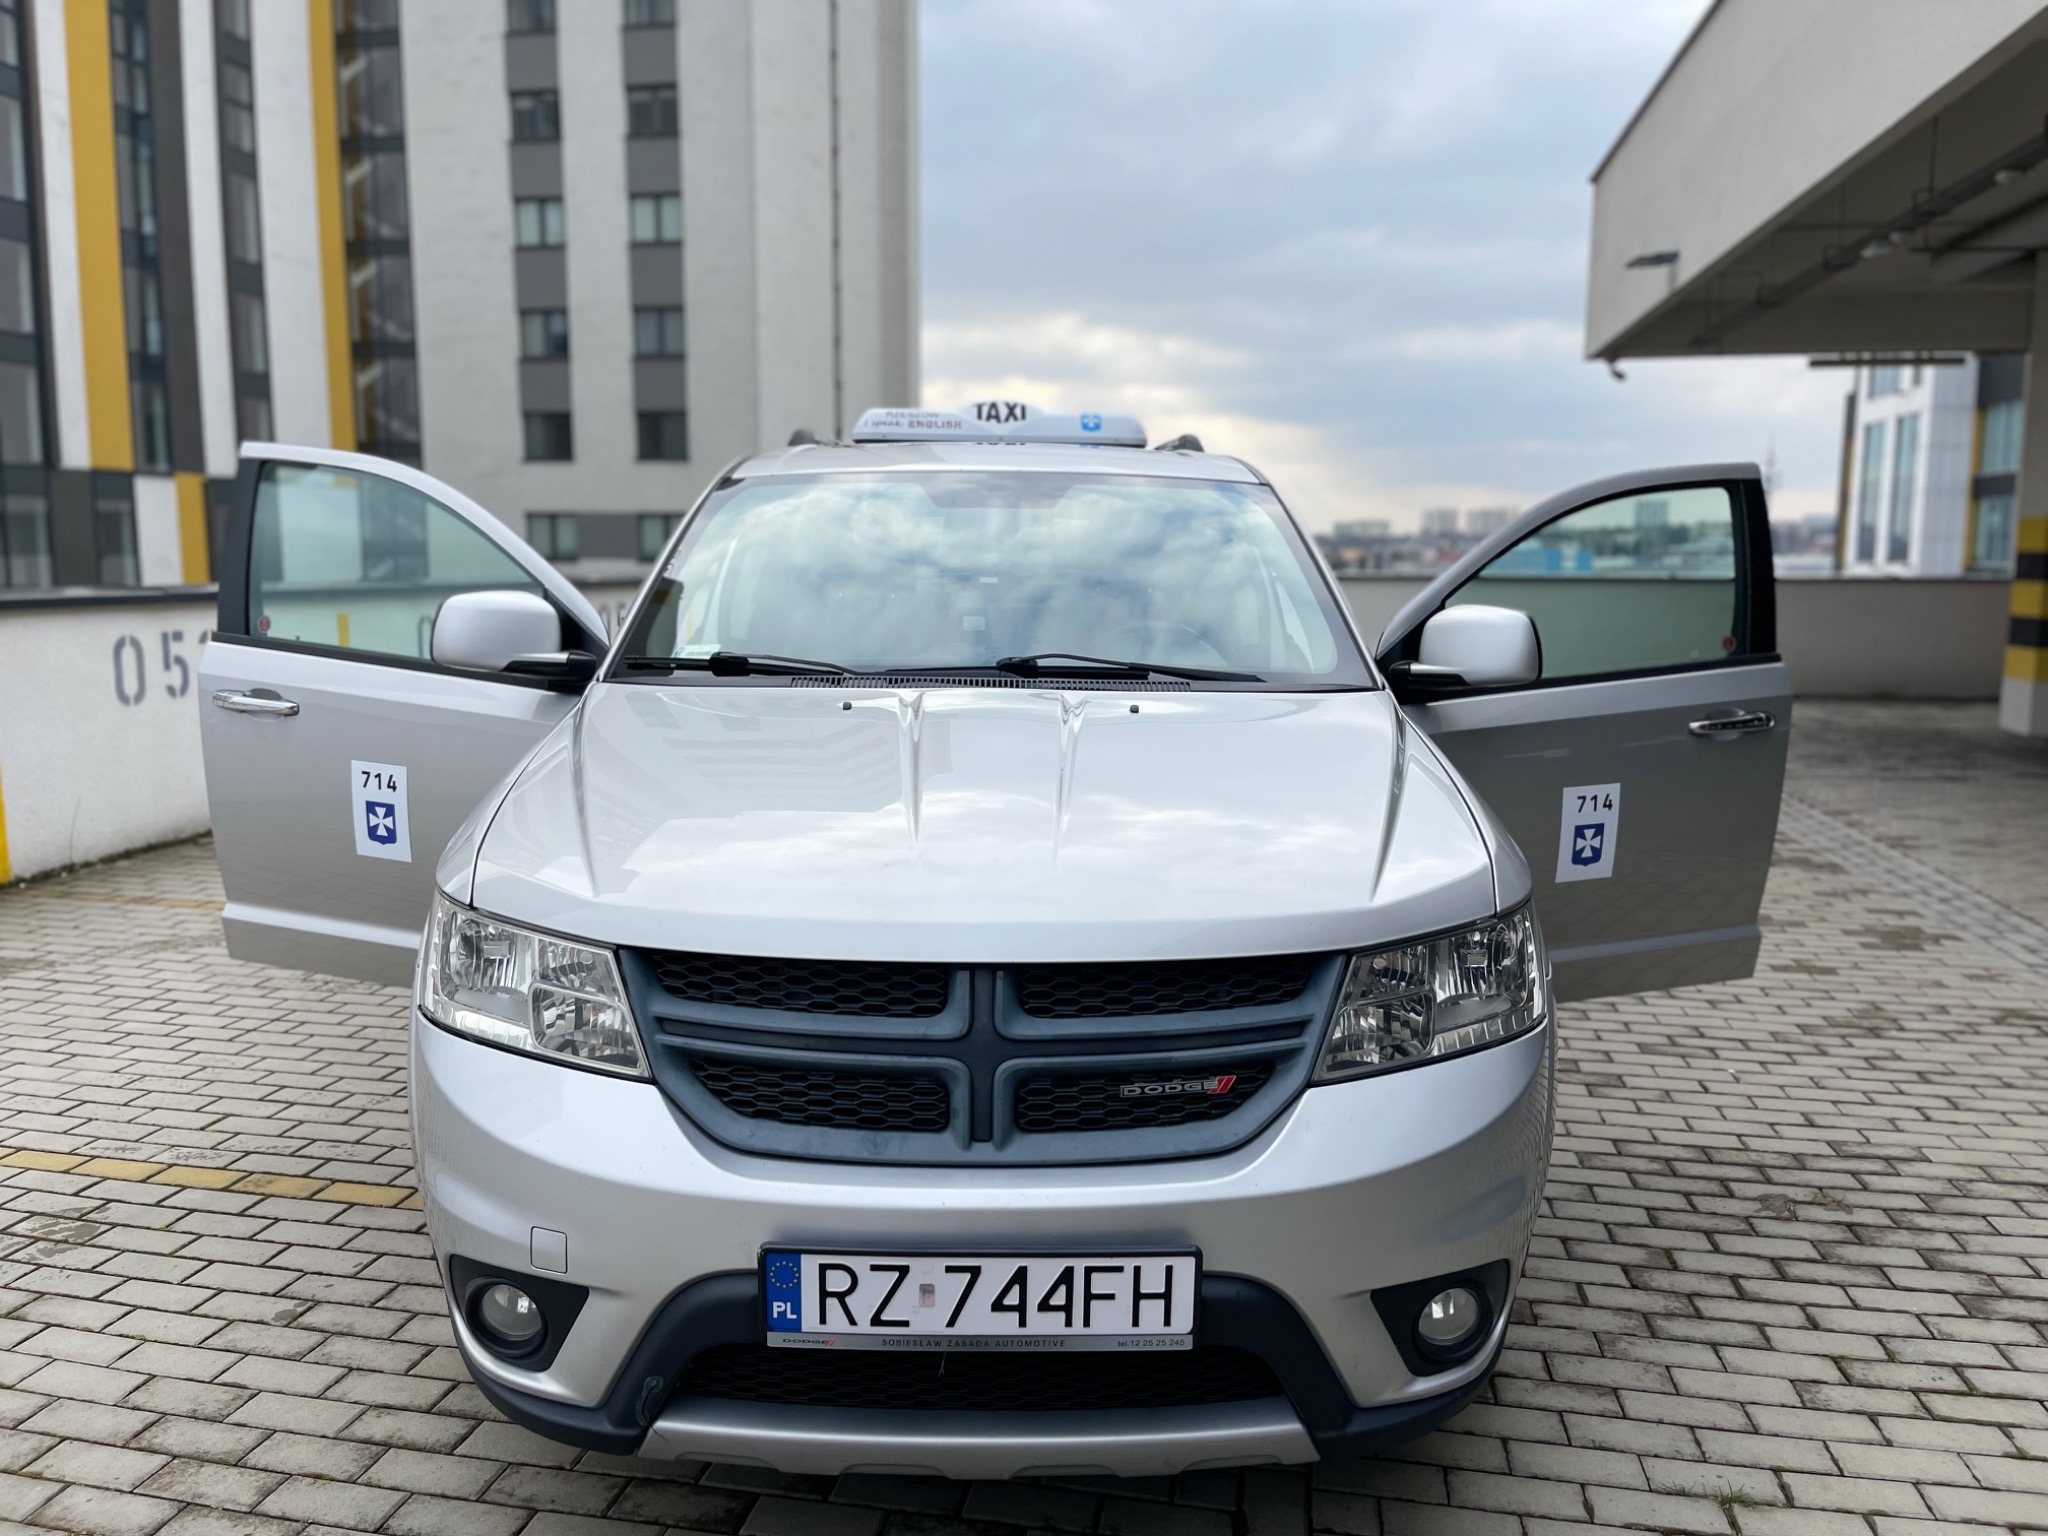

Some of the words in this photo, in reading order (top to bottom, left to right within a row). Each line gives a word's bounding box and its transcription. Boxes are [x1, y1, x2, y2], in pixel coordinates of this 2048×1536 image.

[975, 402, 1026, 423] TAXI
[871, 419, 904, 429] speak
[908, 420, 962, 429] ENGLISH
[113, 630, 208, 707] 05
[361, 770, 397, 792] 714
[1577, 793, 1613, 813] 714
[1123, 1081, 1218, 1096] DODGE
[818, 1263, 910, 1327] RZ
[944, 1264, 1173, 1328] 744FH
[773, 1301, 797, 1319] PL
[882, 1338, 942, 1347] SOBIESŁAW
[947, 1339, 990, 1348] ZASADA
[994, 1339, 1066, 1348] AUTOMOTIVE
[1143, 1339, 1153, 1347] 25
[1156, 1339, 1166, 1347] 25
[1169, 1338, 1185, 1346] 245
